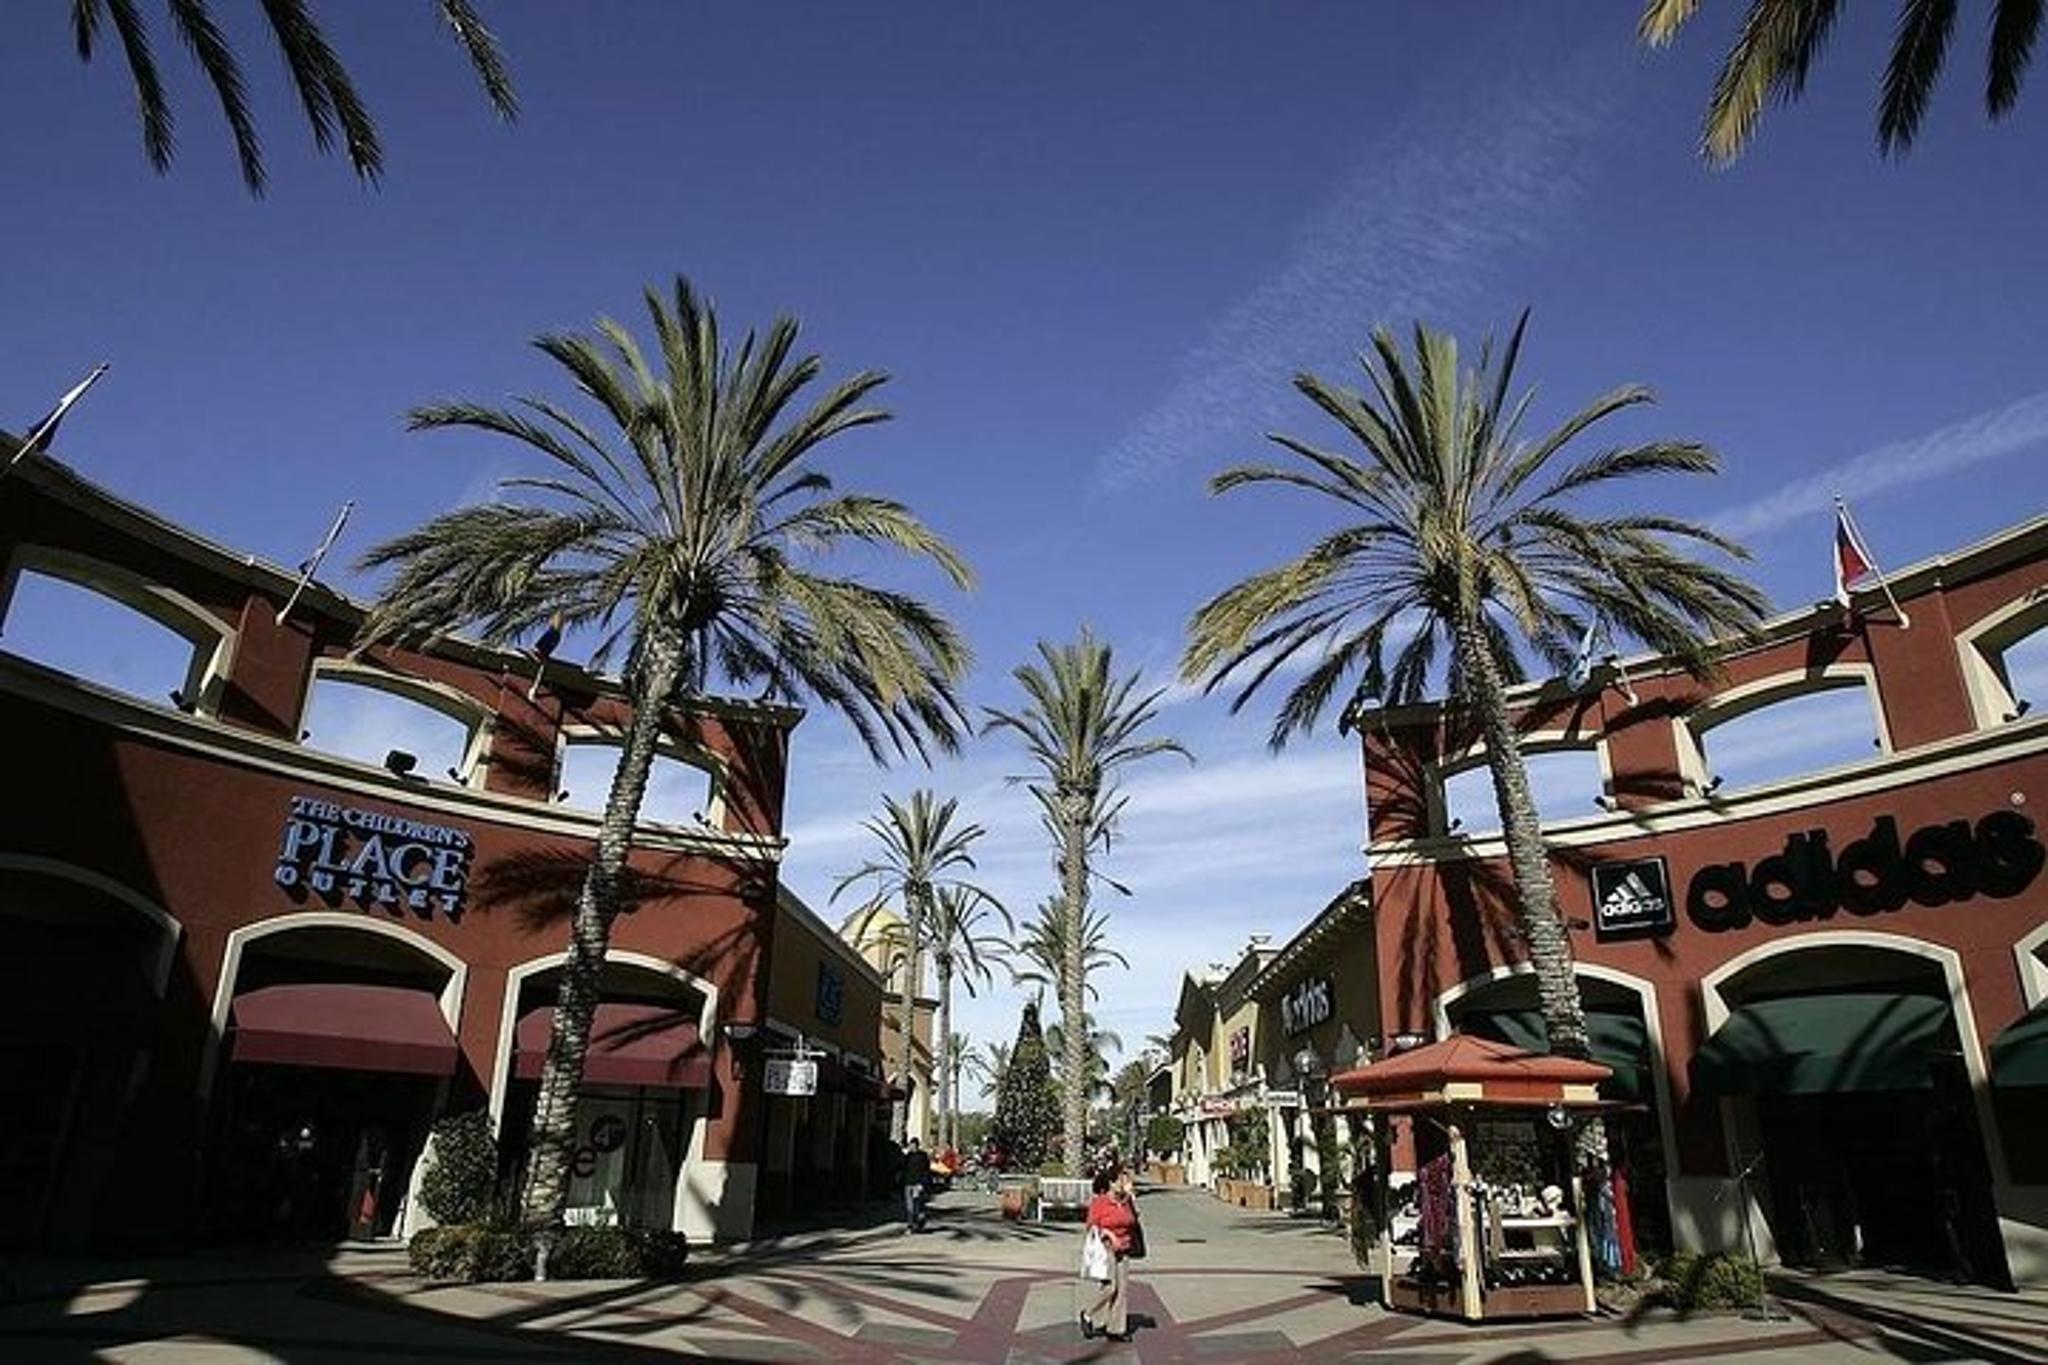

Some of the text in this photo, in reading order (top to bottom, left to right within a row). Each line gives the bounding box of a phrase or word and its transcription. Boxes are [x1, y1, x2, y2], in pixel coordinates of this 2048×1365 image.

[292, 796, 341, 821] THE
[279, 818, 465, 891] PLACE
[1687, 810, 2046, 933] adidas
[274, 864, 460, 912] OUTLET
